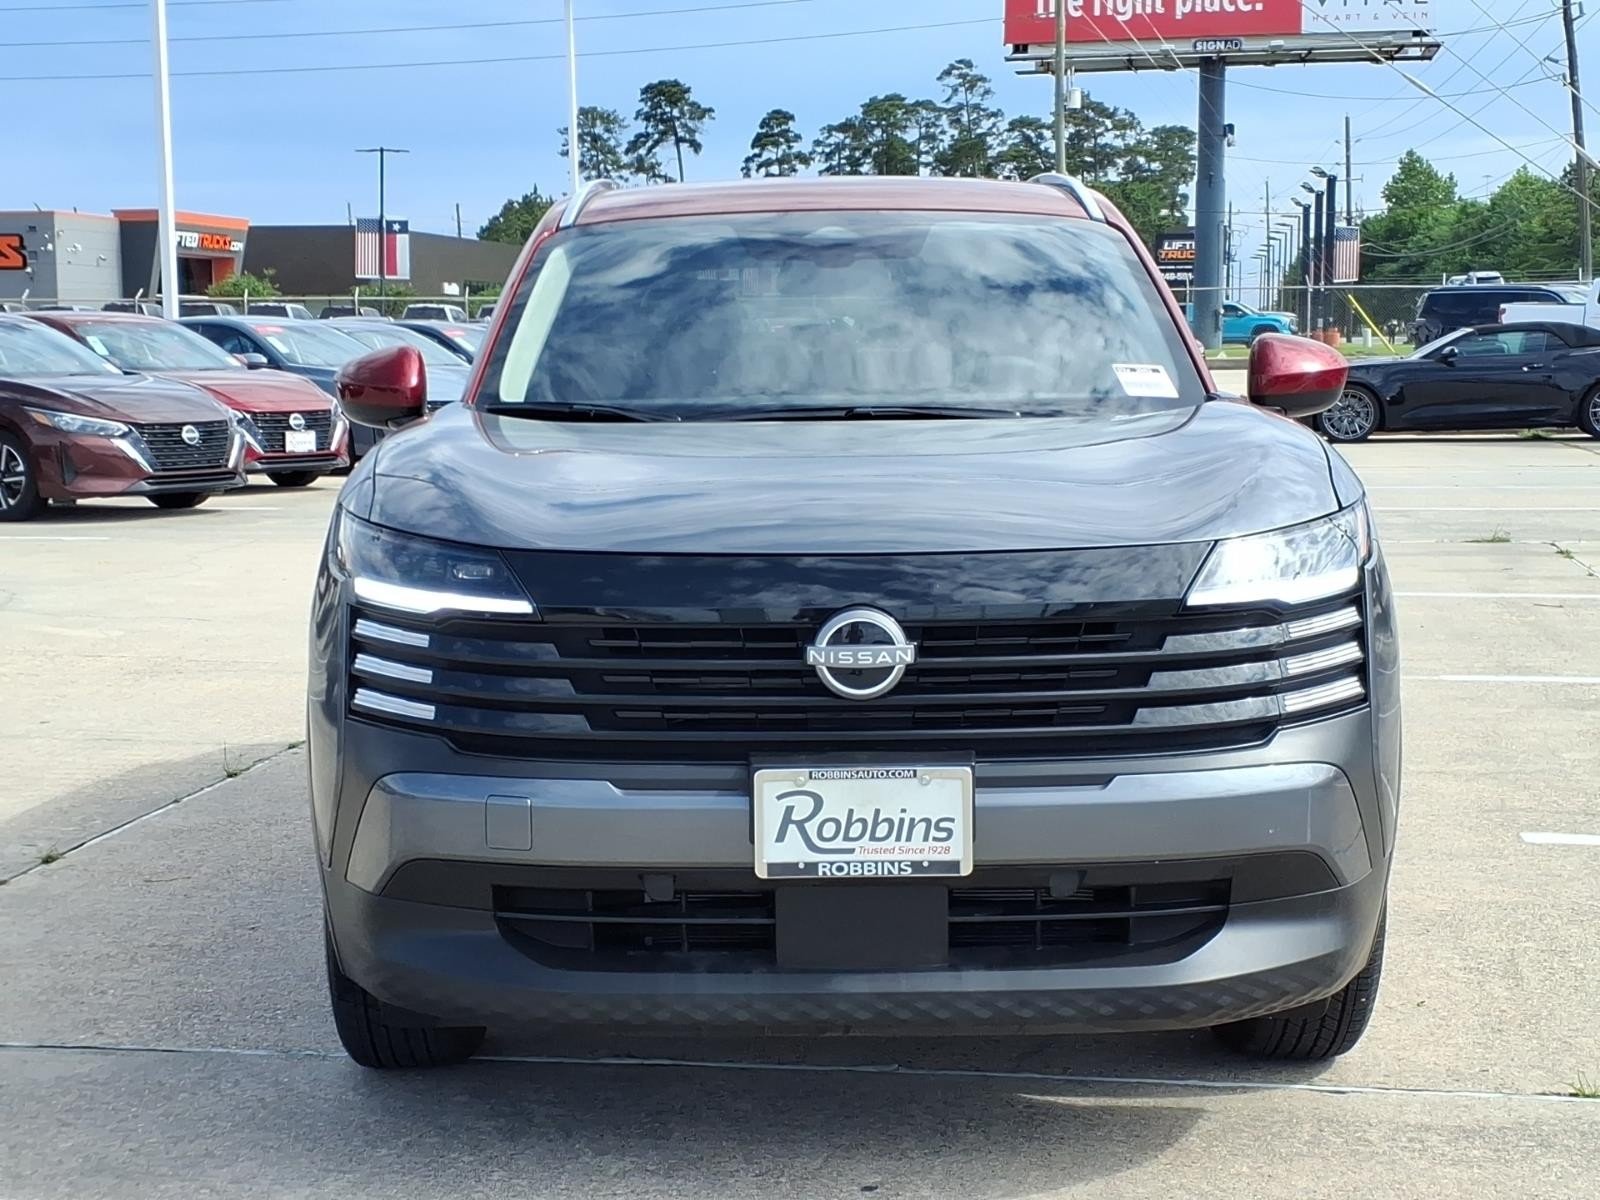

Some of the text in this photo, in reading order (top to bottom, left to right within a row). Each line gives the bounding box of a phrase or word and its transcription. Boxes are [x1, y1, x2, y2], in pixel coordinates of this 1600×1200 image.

[1035, 0, 1264, 21] te right place.
[1312, 11, 1429, 22] HEART & VEIN
[1195, 40, 1241, 51] SIGNAD
[809, 648, 912, 665] NISSAN
[811, 769, 915, 780] ROBBINSAUTO.COM
[774, 789, 956, 855] Robbins
[858, 845, 951, 856] Trusted Since 1928
[817, 861, 913, 876] ROBBINS
